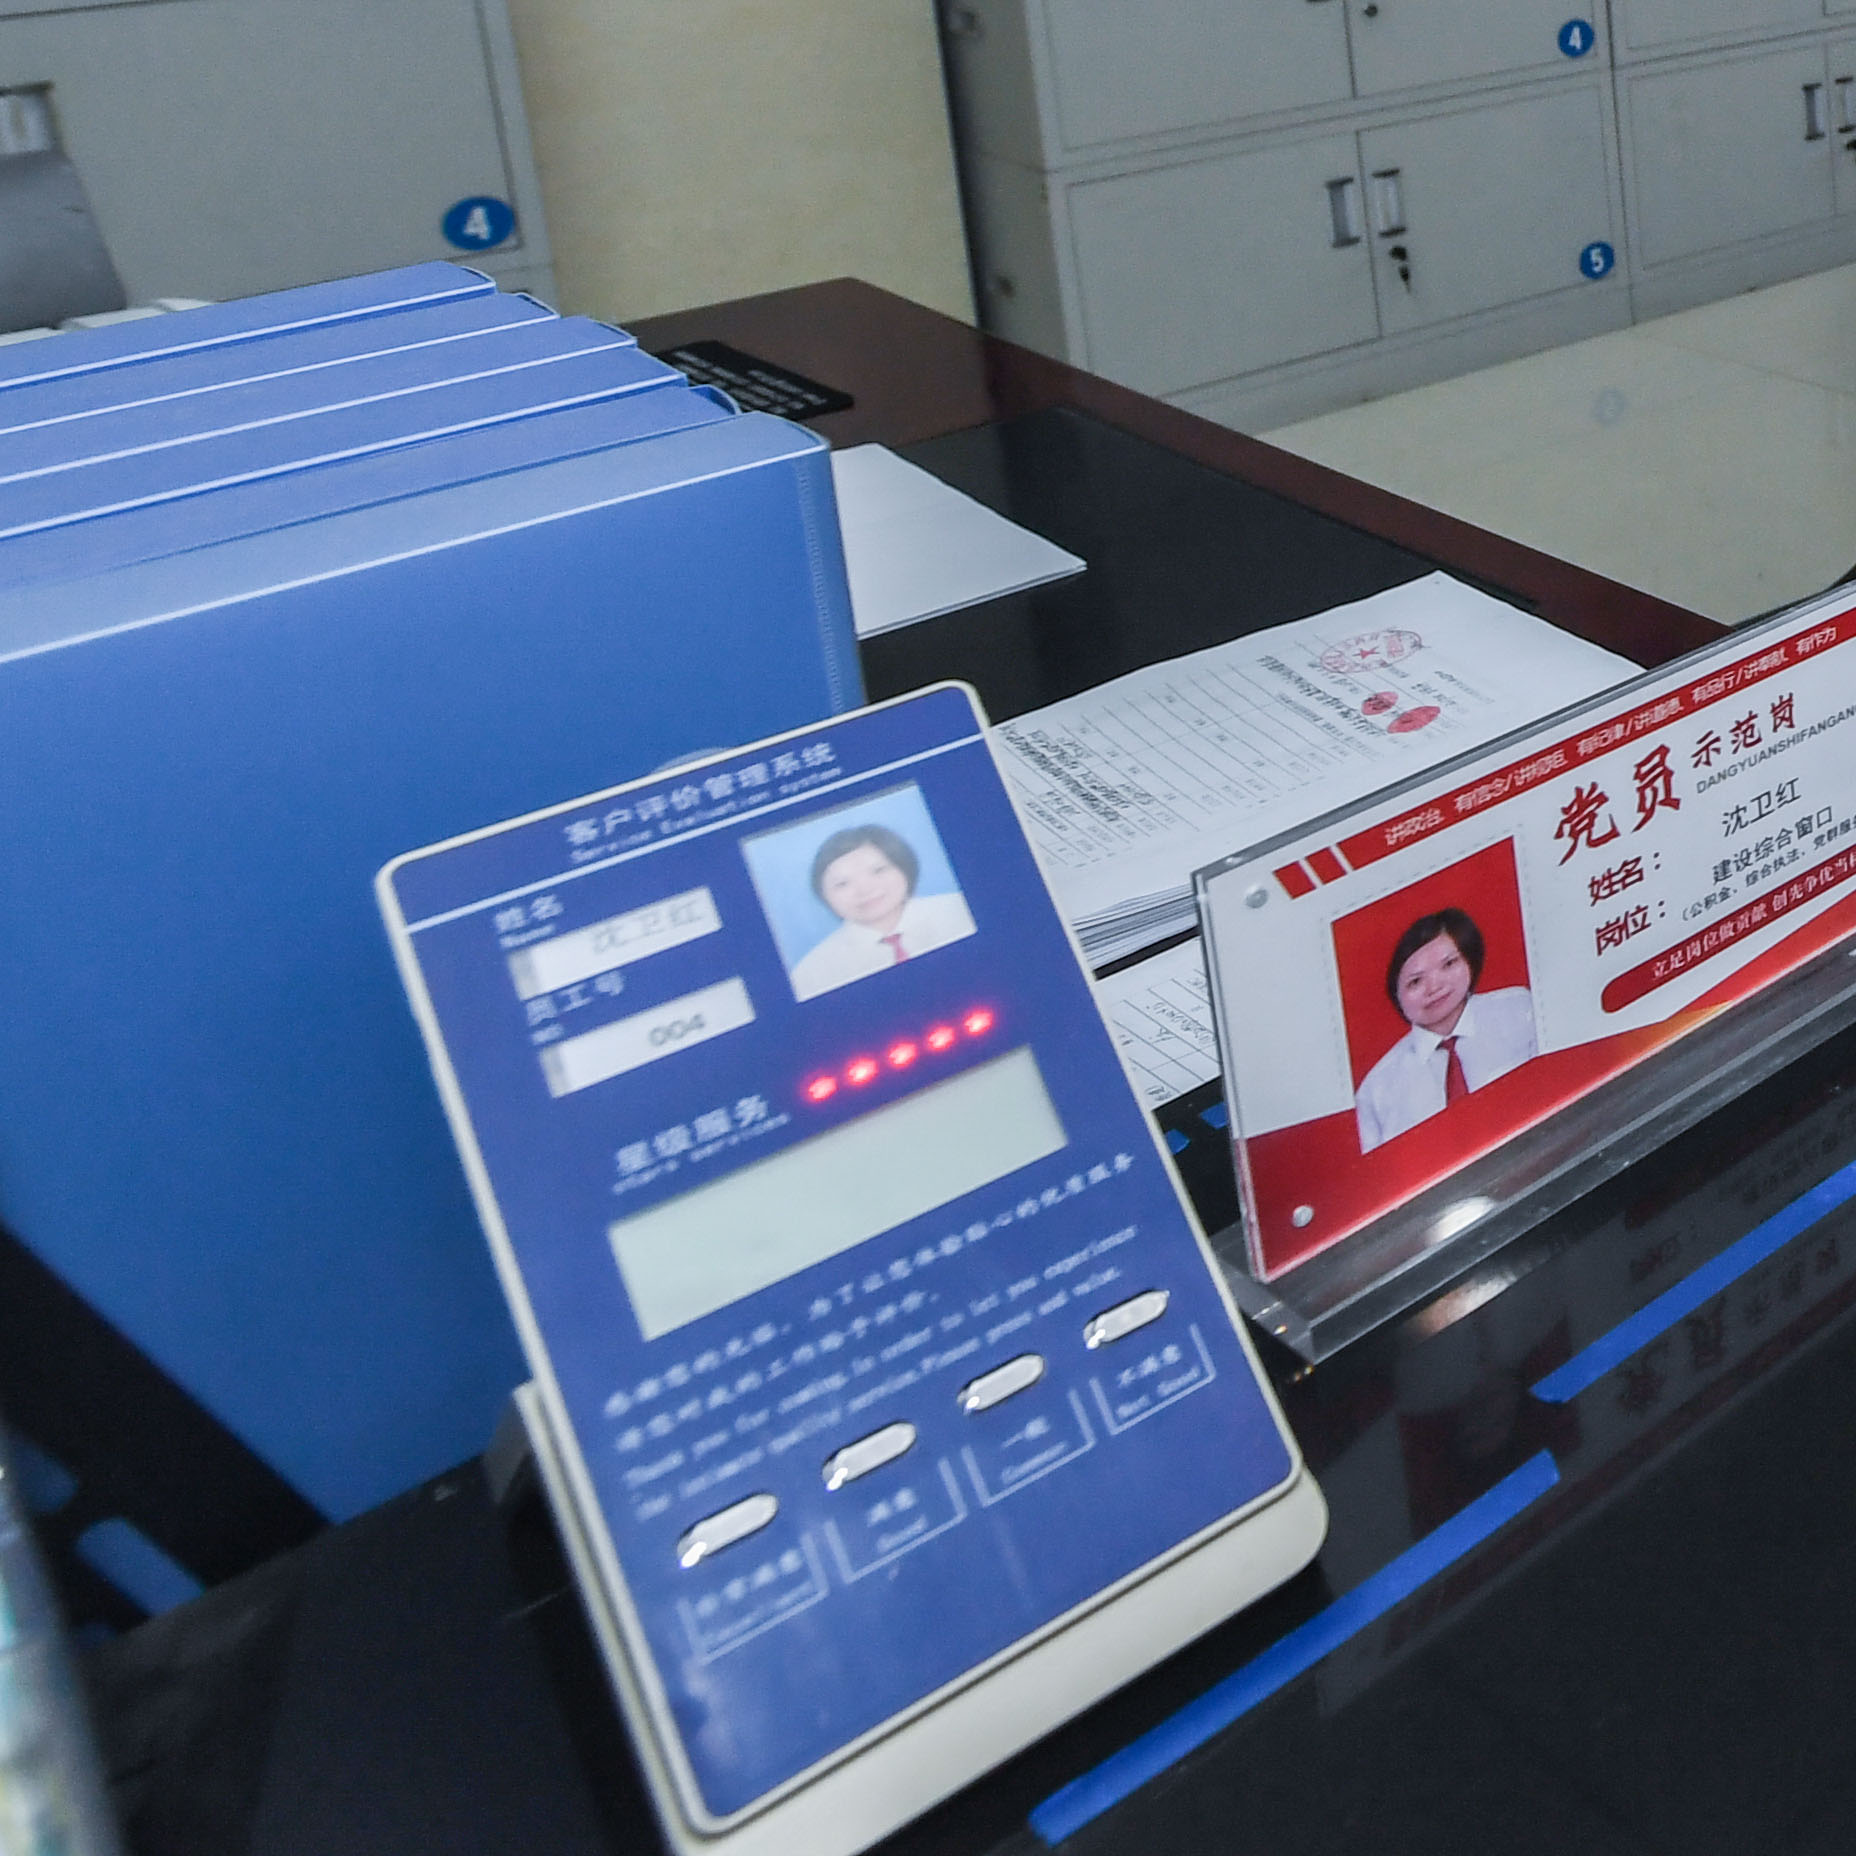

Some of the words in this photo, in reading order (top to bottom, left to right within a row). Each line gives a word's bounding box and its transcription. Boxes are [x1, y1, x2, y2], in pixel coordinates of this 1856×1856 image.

[1568, 26, 1582, 50] 4
[463, 207, 489, 240] 4
[1590, 248, 1604, 272] 5
[564, 742, 836, 847] 客户评价管理系统
[1721, 777, 1802, 838] 沈卫红
[1712, 805, 1834, 886] 建设综合窗口
[495, 895, 563, 938] 姓名
[526, 966, 623, 1025] 员工号
[649, 1014, 706, 1047] 004
[617, 1095, 766, 1175] 星级服务
